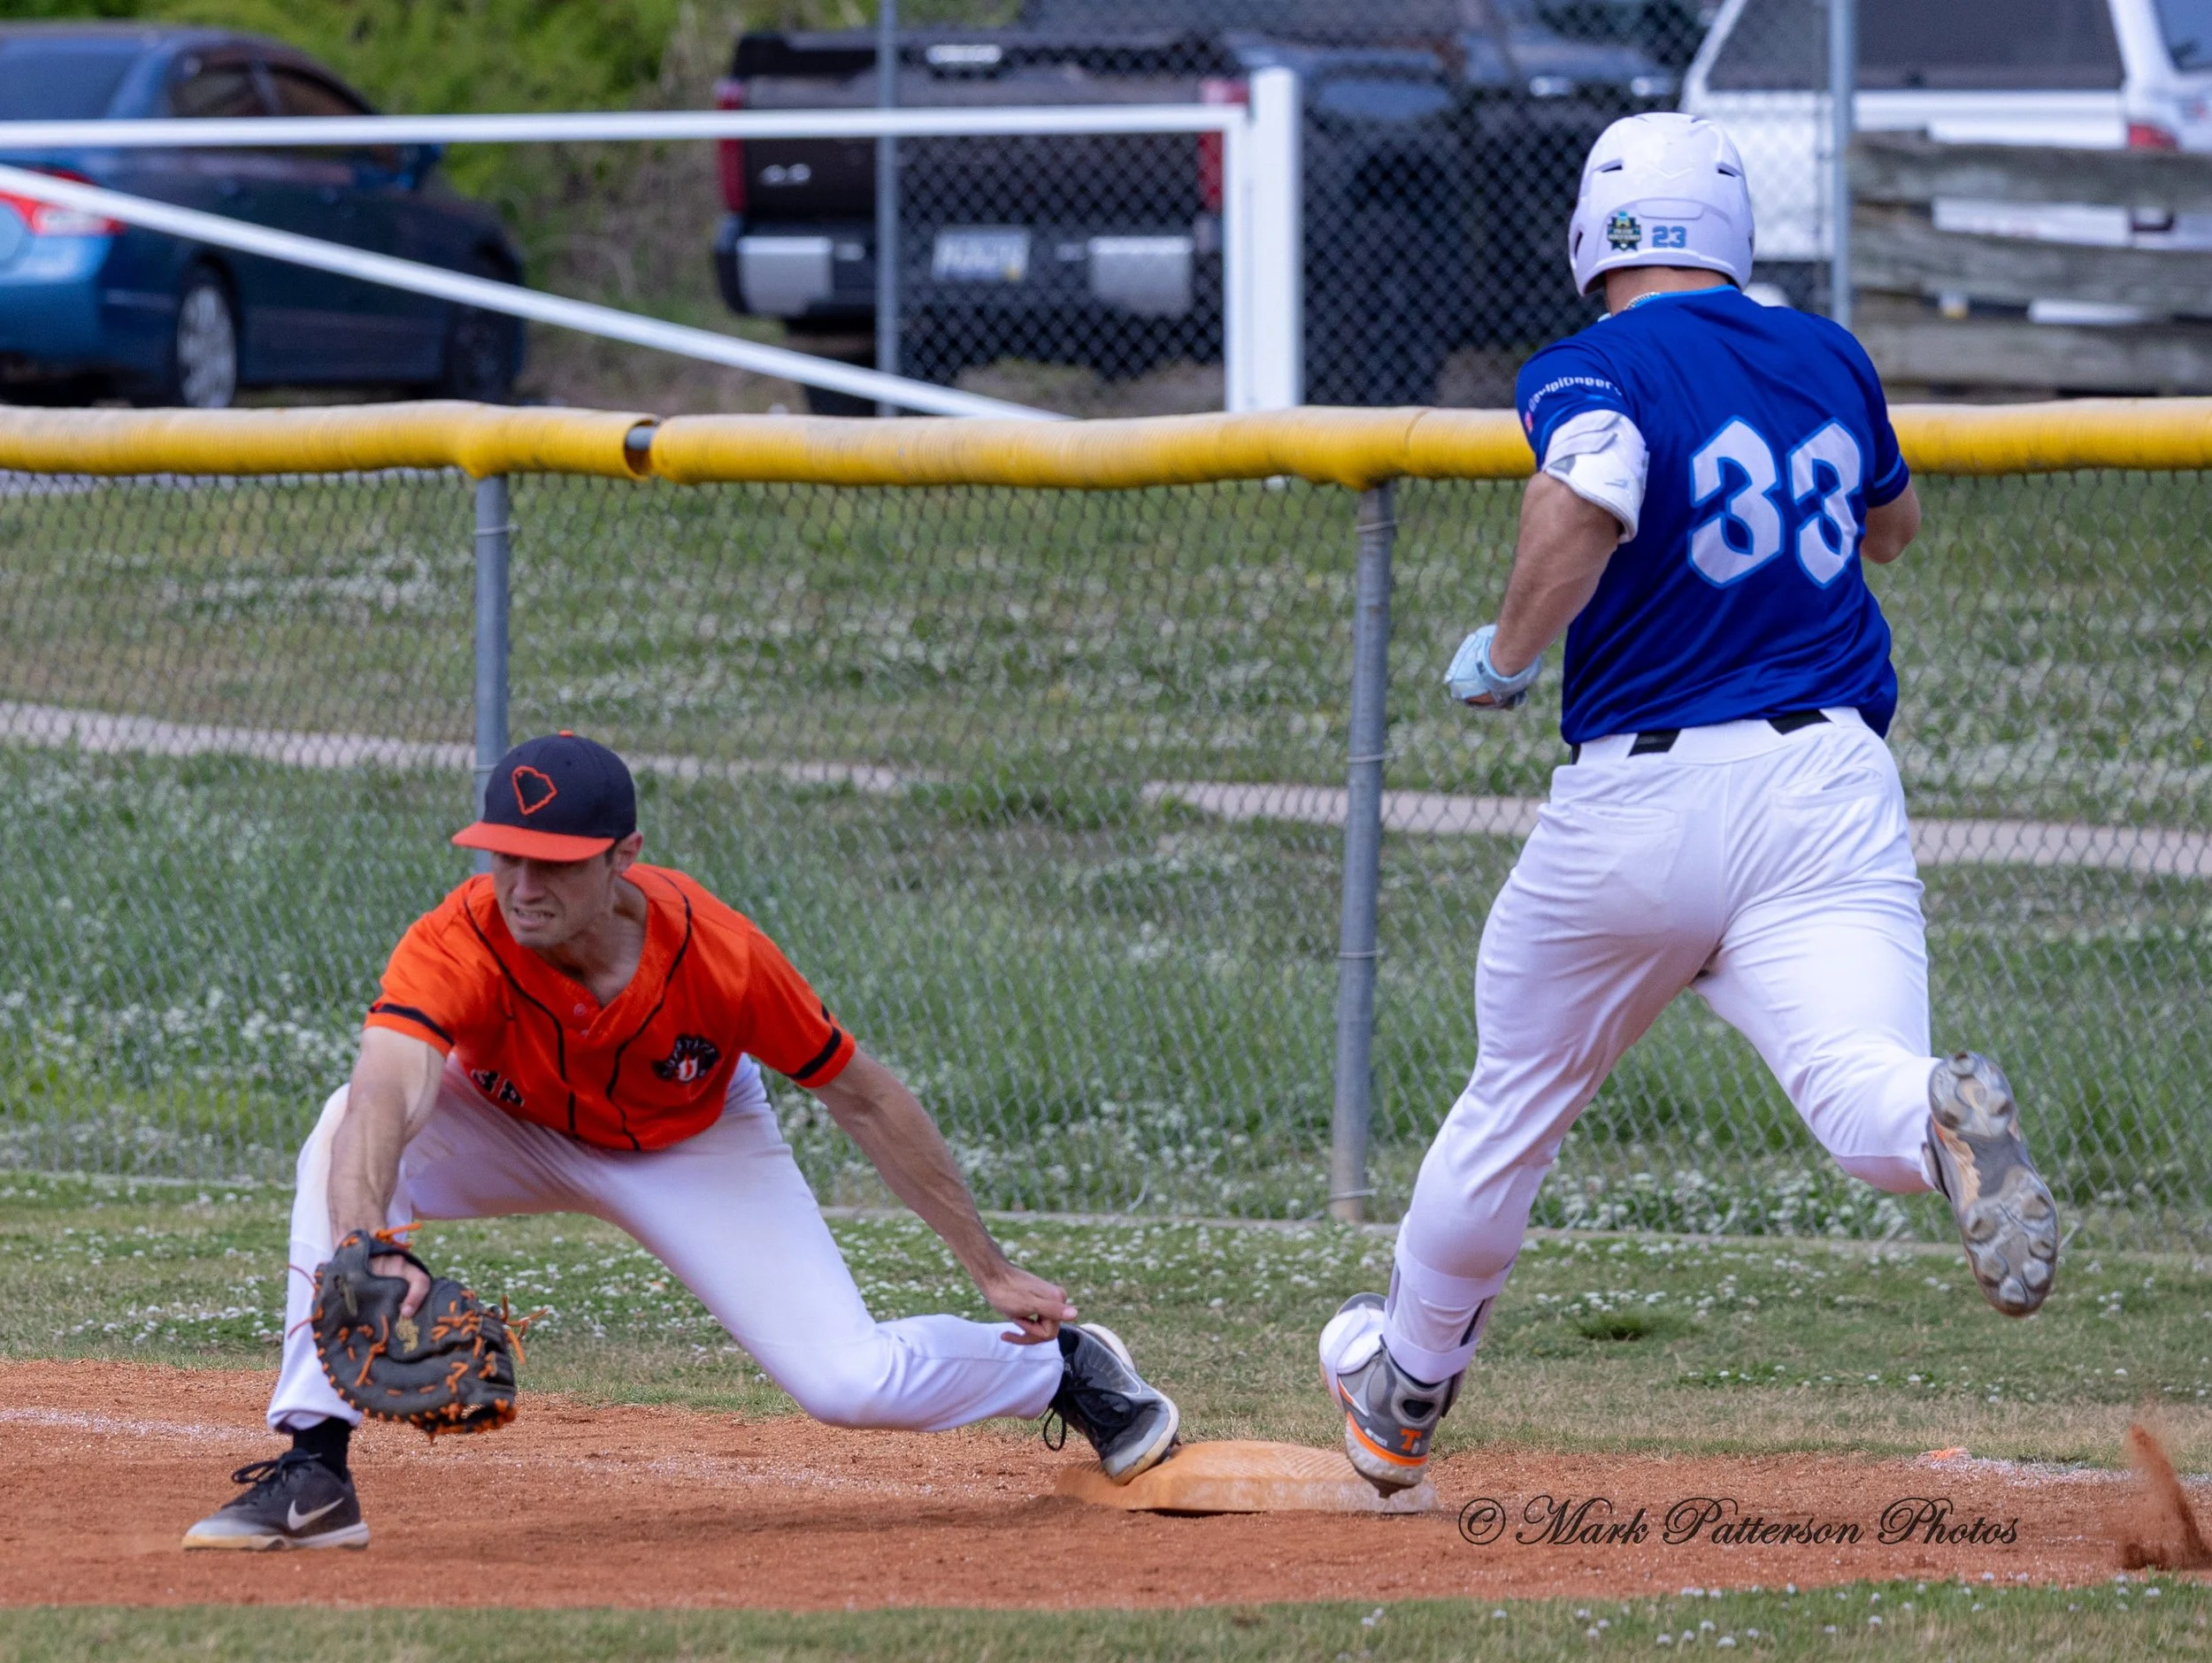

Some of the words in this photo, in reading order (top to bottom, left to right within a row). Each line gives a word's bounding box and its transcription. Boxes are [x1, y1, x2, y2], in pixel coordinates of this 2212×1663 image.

[1652, 226, 1686, 249] 23
[1688, 415, 1863, 589] 33
[1401, 1428, 1422, 1451] T
